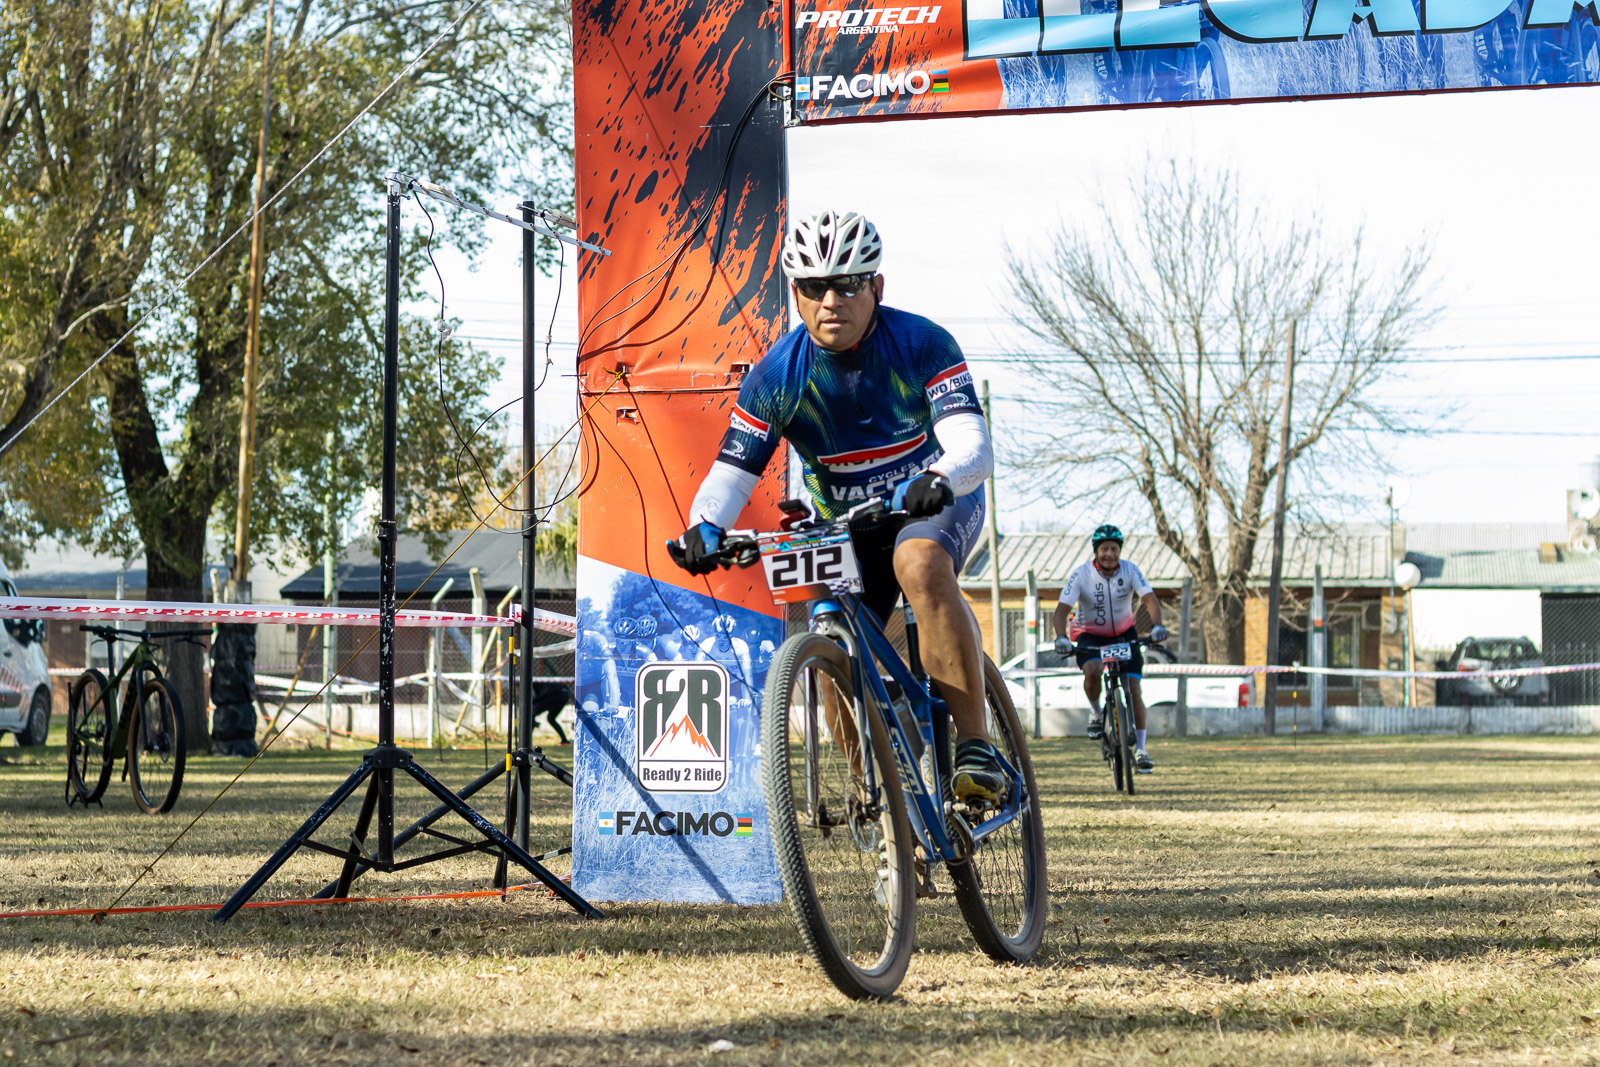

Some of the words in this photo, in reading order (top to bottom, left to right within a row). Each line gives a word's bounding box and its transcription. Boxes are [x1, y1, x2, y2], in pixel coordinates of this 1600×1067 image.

[795, 5, 943, 29] PROTECH
[836, 24, 899, 35] ARGENTINA
[812, 70, 931, 100] FACIMO
[868, 461, 916, 484] CYCLES
[772, 546, 843, 588] 212
[1094, 582, 1107, 627] Cofidis
[1103, 647, 1128, 658] 222
[643, 767, 681, 783] Ready
[684, 768, 691, 781] 2
[694, 767, 722, 782] Ride
[616, 811, 735, 837] FACIMO
